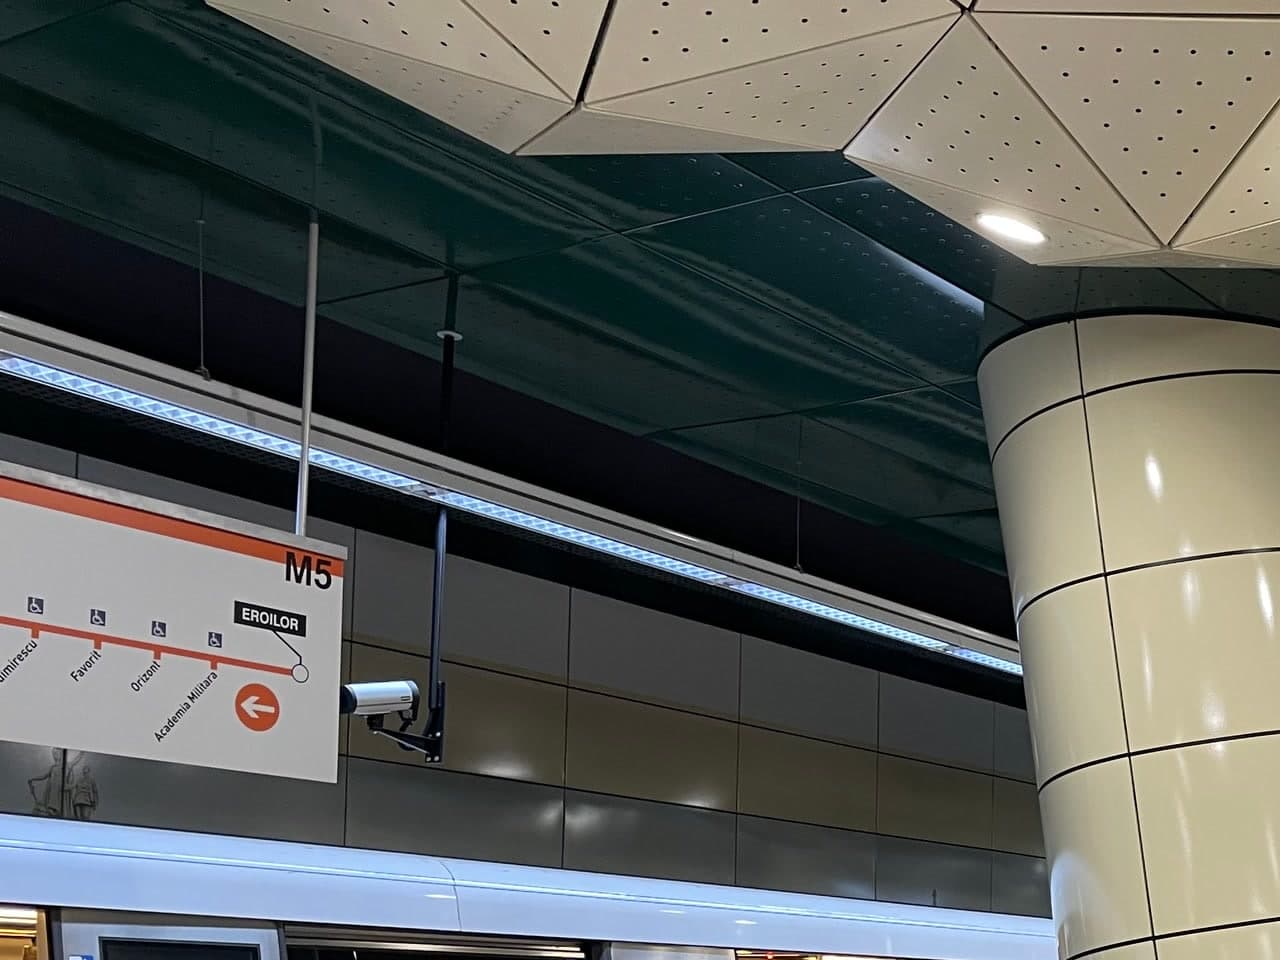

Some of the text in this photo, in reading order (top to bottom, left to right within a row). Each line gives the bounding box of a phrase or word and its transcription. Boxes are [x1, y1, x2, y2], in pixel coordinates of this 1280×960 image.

[285, 551, 332, 590] M5
[241, 607, 299, 631] EROILOR
[70, 650, 102, 682] Favorit
[130, 660, 161, 693] Orizont
[154, 701, 191, 743] Academia
